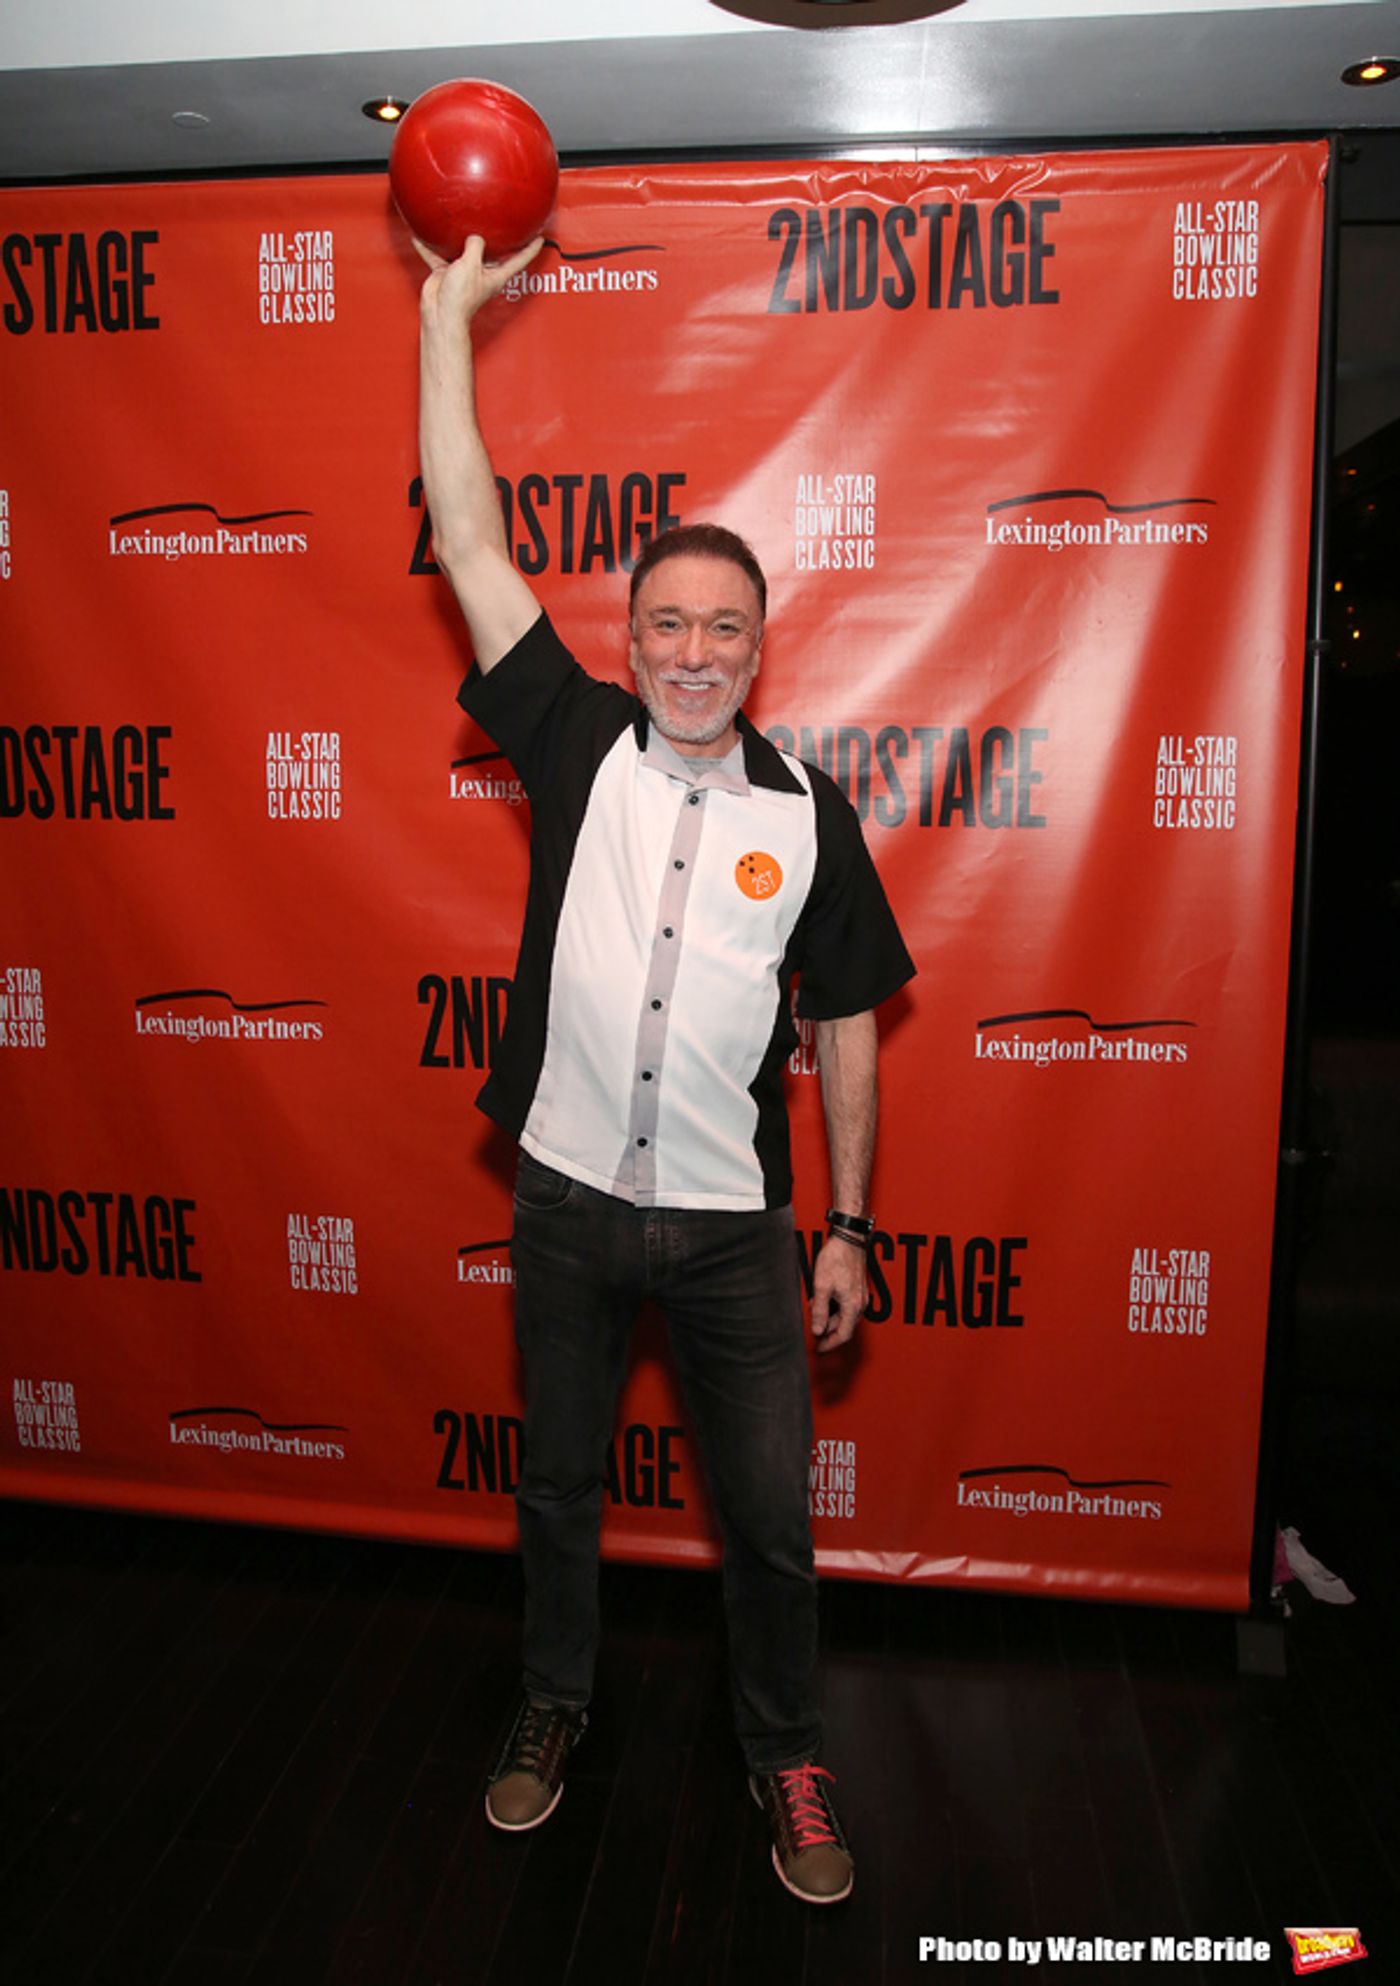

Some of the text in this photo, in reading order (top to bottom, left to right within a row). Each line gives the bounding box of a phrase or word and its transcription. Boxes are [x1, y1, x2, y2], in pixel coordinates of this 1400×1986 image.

[1174, 200, 1259, 233] ALL-STAR
[258, 230, 334, 262] ALL-STAR
[767, 199, 1060, 313] 2NDSTAGE
[1173, 233, 1258, 267] BOWLING
[2, 230, 160, 336] STAGE
[259, 261, 334, 292] BOWLING
[502, 264, 659, 302] gtonPartners
[1172, 266, 1258, 300] CLASSIC
[259, 291, 335, 324] CLASSIC
[795, 474, 876, 505] ALL-STAR
[408, 472, 687, 576] 2STAGE
[795, 505, 875, 537] BOWLING
[985, 517, 1208, 553] LexingtonPartners
[109, 529, 308, 561] LexingtonPartners
[795, 538, 875, 570] CLASSIC
[266, 732, 341, 761] ALL-STAR
[1156, 736, 1238, 767] ALL-STAR
[0, 725, 176, 821] DSTAGE
[266, 761, 341, 790] BOWLING
[1155, 767, 1236, 798] BOWLING
[267, 790, 341, 820] CLASSIC
[1153, 798, 1236, 830] CLASSIC
[135, 1009, 323, 1043] LexingtonPartners
[974, 1032, 1187, 1067] LexingtonPartners
[0, 1187, 203, 1283] NDSTAGE
[287, 1213, 354, 1241] ALL-STAR
[288, 1239, 356, 1269] BOWLING
[1131, 1247, 1211, 1279] ALL-STAR
[290, 1265, 359, 1295] CLASSIC
[1129, 1276, 1209, 1307] BOWLING
[1127, 1304, 1208, 1336] CLASSIC
[13, 1378, 75, 1406] ALL-STAR
[14, 1403, 79, 1430] BOWLING
[18, 1427, 82, 1453] CLASSIC
[168, 1422, 345, 1460] LexingtonPartners
[811, 1439, 856, 1467] -STAR
[808, 1465, 856, 1493] WLING
[808, 1491, 856, 1518] SSIC
[956, 1482, 1162, 1520] LexingtonPartners
